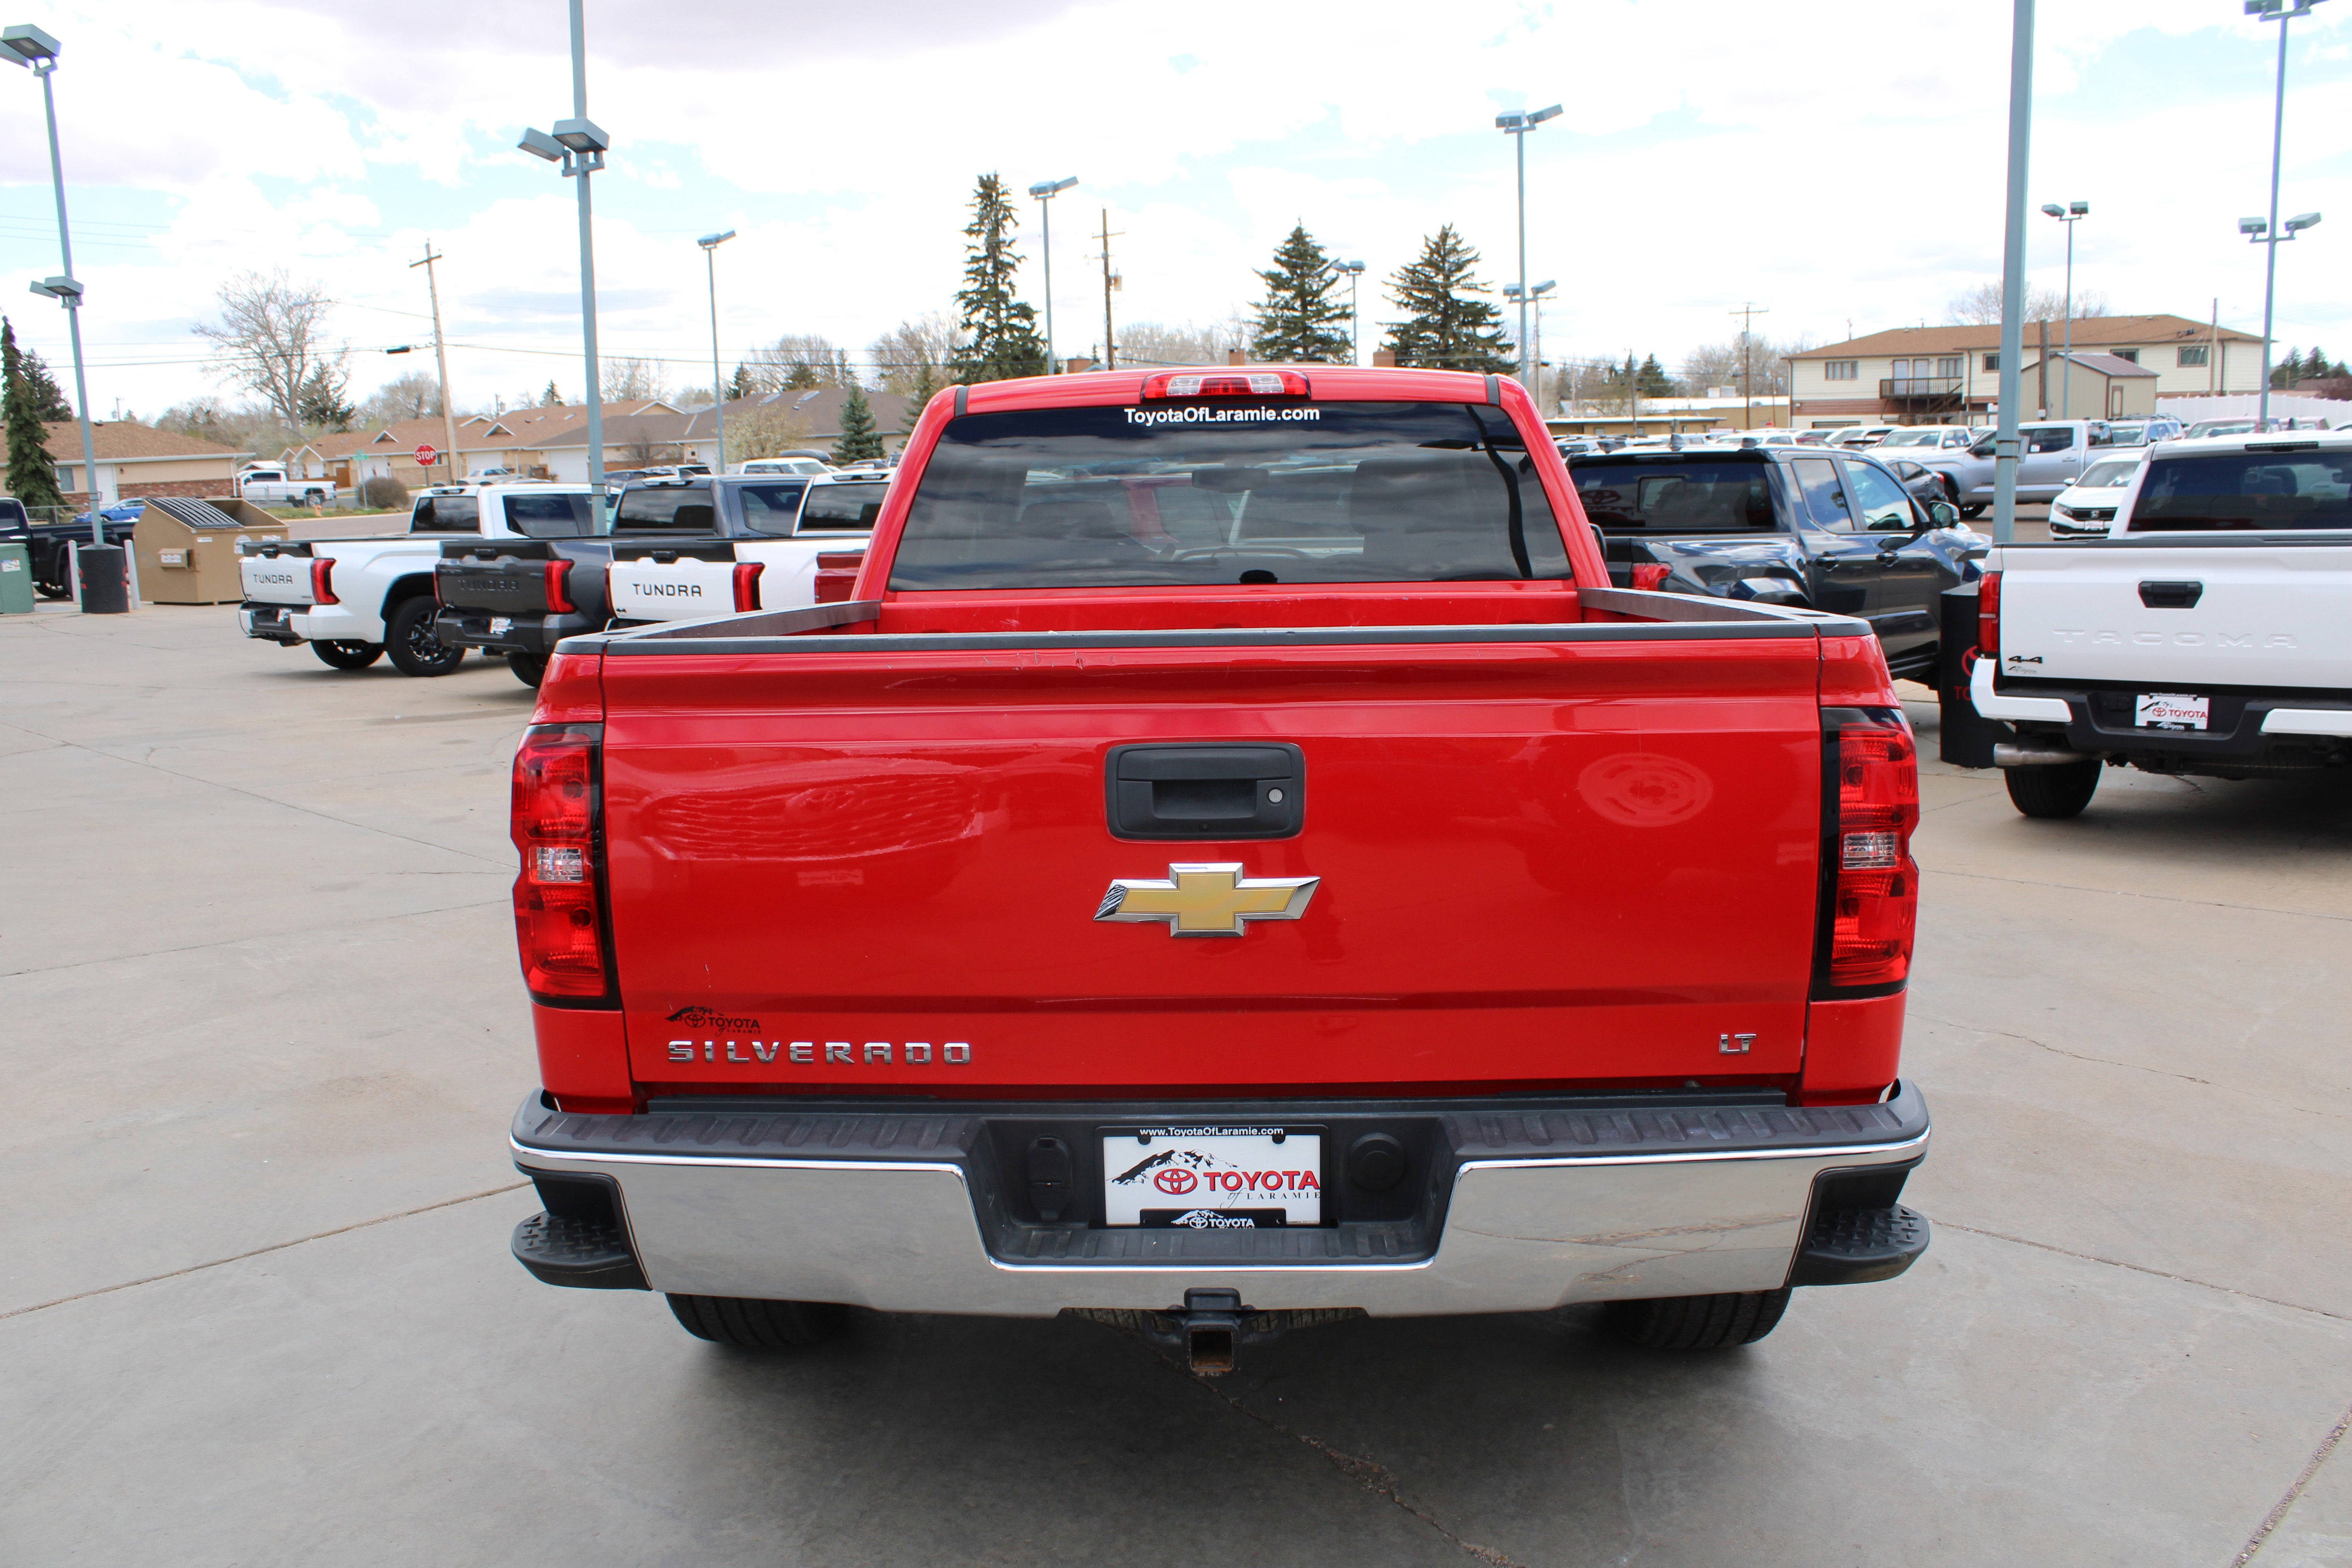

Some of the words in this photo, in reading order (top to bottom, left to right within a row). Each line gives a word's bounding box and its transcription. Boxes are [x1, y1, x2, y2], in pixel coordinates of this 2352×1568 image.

[1124, 406, 1320, 427] ToyotaOfLaramie.com
[416, 450, 435, 461] STOP
[253, 574, 294, 585] TUNDRA
[457, 579, 519, 592] TUNDRA
[632, 584, 702, 597] TUNDRA
[2052, 629, 2298, 648] TACOMA
[2168, 709, 2208, 718] TOYOTA
[708, 1017, 760, 1029] TOYOTA
[1719, 1033, 1757, 1054] LT
[668, 1040, 971, 1064] SILVERADO
[1140, 1126, 1284, 1137] www.ToyotaOfLaramie.com
[1203, 1171, 1321, 1192] TOYOTA
[1247, 1191, 1321, 1200] LARAMIE
[1209, 1218, 1255, 1227] TOYOTA
